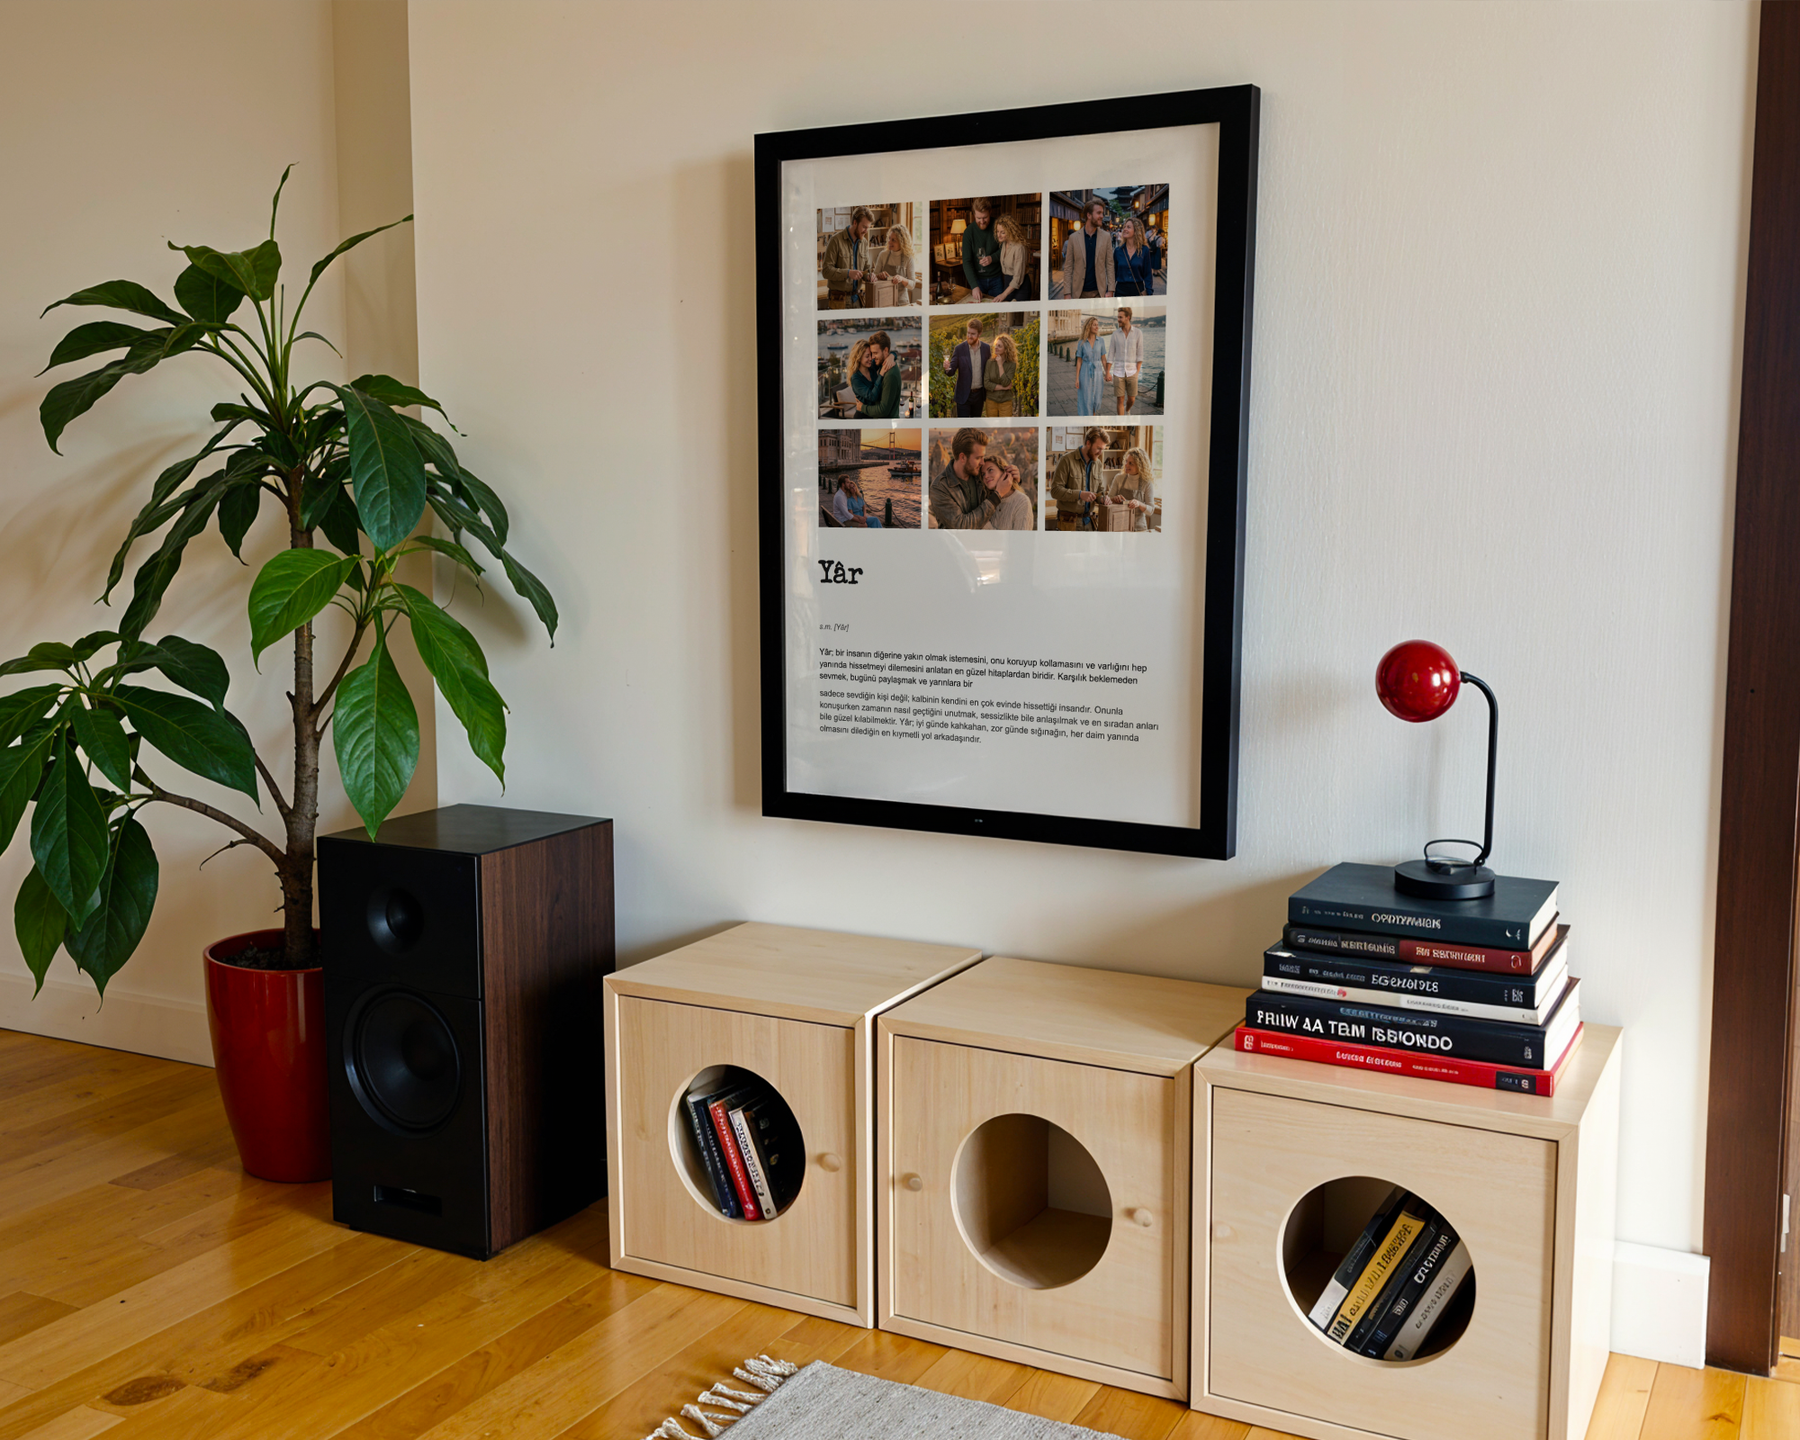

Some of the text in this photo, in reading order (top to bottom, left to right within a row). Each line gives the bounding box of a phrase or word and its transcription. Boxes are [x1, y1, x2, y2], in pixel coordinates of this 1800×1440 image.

[818, 559, 864, 585] Yâr
[819, 661, 848, 669] yanında
[848, 661, 886, 672] hissetmeyi
[887, 663, 924, 673] dilemesini
[925, 666, 953, 674] anlatan
[965, 667, 986, 678] güzel
[987, 668, 1030, 679] hitaplardan
[1057, 672, 1087, 683] Karşılık
[1088, 674, 1138, 684] beklemeden
[835, 648, 844, 656] bir
[846, 649, 872, 658] insanın
[873, 650, 902, 660] diğerine
[903, 652, 924, 662] yakın
[925, 653, 948, 662] olmak
[949, 654, 989, 665] istemesini,
[990, 657, 1005, 665] onu
[1006, 657, 1038, 668] koruyup
[1039, 659, 1084, 669] kollamasını
[1085, 662, 1096, 670] ve
[1097, 662, 1130, 673] varlığını
[1131, 663, 1147, 674] hep
[819, 673, 848, 682] sevmek,
[849, 673, 876, 684] bugünü
[878, 675, 917, 685] paylaşmak
[918, 678, 928, 686] ve
[962, 679, 973, 688] bir
[819, 701, 860, 711] konuşurken
[861, 705, 892, 713] zamanın
[893, 706, 911, 714] nasıl
[980, 712, 1019, 722] sessizlikte
[1020, 713, 1034, 722] bile
[1036, 715, 1078, 726] anlaşılmak
[1103, 720, 1134, 729] sıradan
[1136, 722, 1159, 730] anları
[820, 689, 845, 698] sadece
[846, 691, 876, 701] sevdiğin
[876, 692, 889, 702] kişi
[911, 694, 940, 704] kalbinin
[941, 696, 968, 706] kendini
[980, 699, 994, 708] çok
[996, 700, 1022, 709] evinde
[1094, 705, 1123, 716] Onunla
[819, 712, 832, 720] bile
[833, 713, 853, 723] güzel
[925, 720, 949, 730] günde
[950, 721, 988, 732] kahkahan,
[1004, 725, 1028, 735] günde
[1070, 729, 1084, 738] her
[1085, 730, 1105, 740] daim
[1107, 733, 1139, 742] yanında
[819, 724, 849, 734] olmasını
[850, 726, 880, 737] dilediğin
[921, 732, 932, 741] yol
